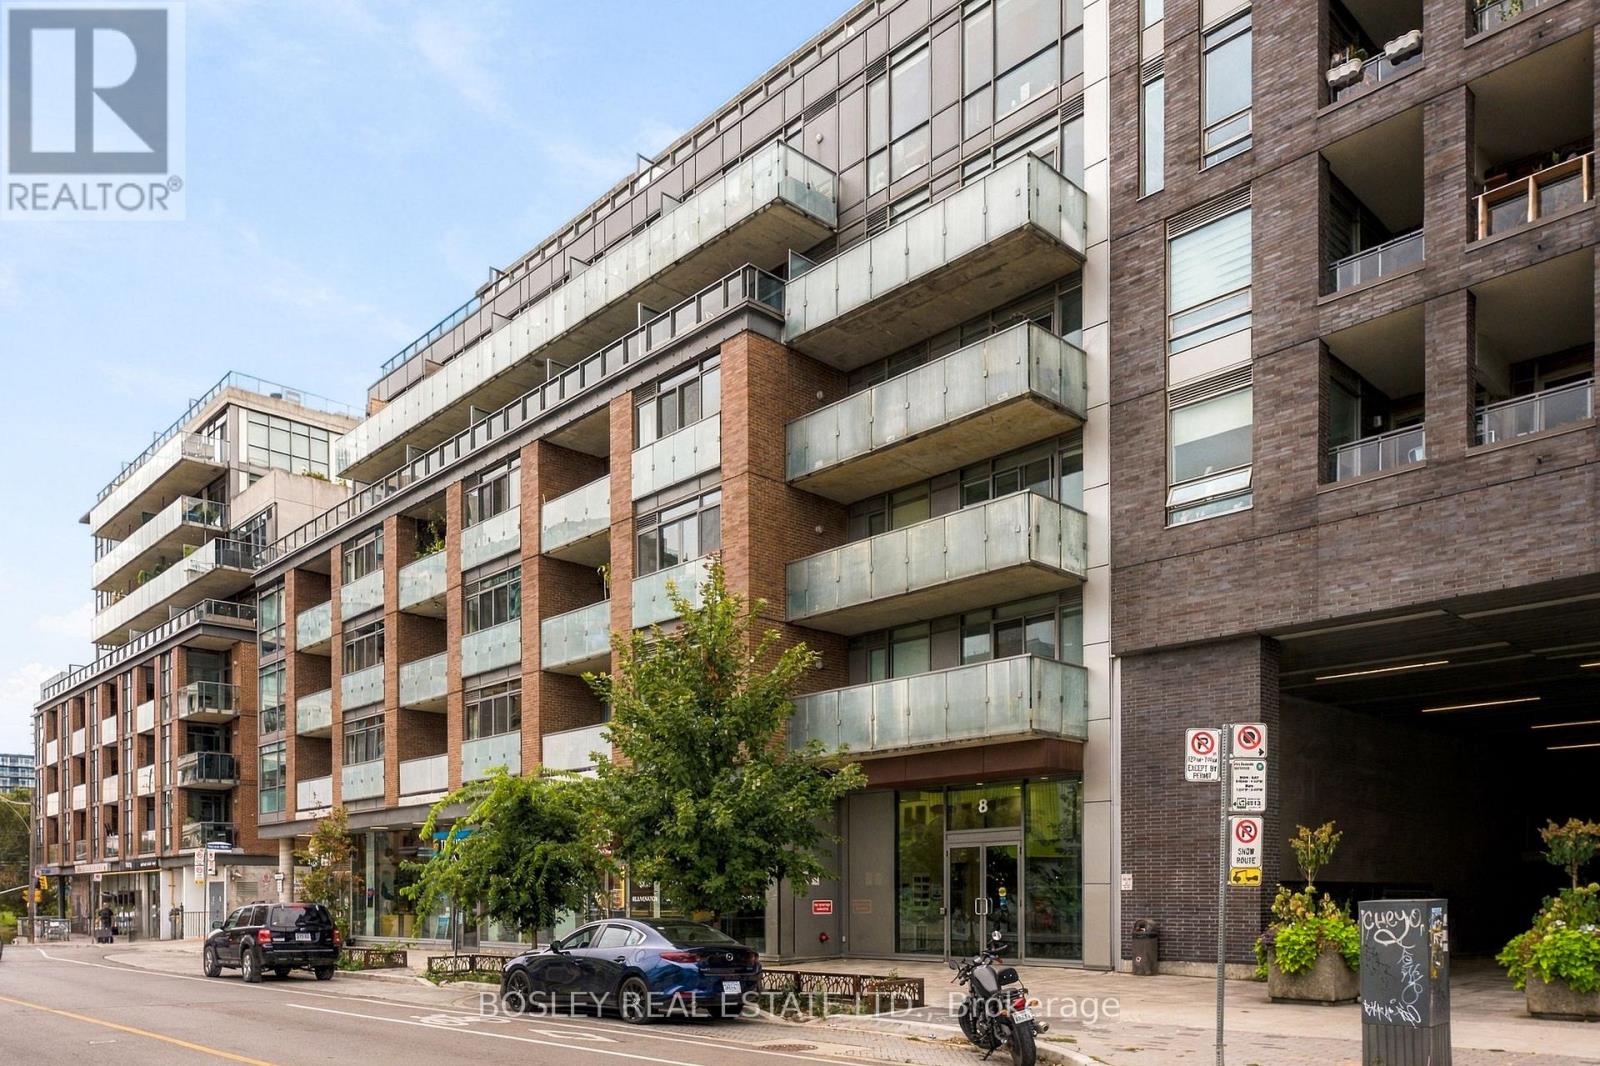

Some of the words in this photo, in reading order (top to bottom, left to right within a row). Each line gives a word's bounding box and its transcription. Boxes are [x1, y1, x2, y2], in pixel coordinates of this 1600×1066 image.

[978, 799, 988, 813] 8
[1237, 847, 1255, 856] SNOW
[1236, 856, 1256, 865] ROUTE
